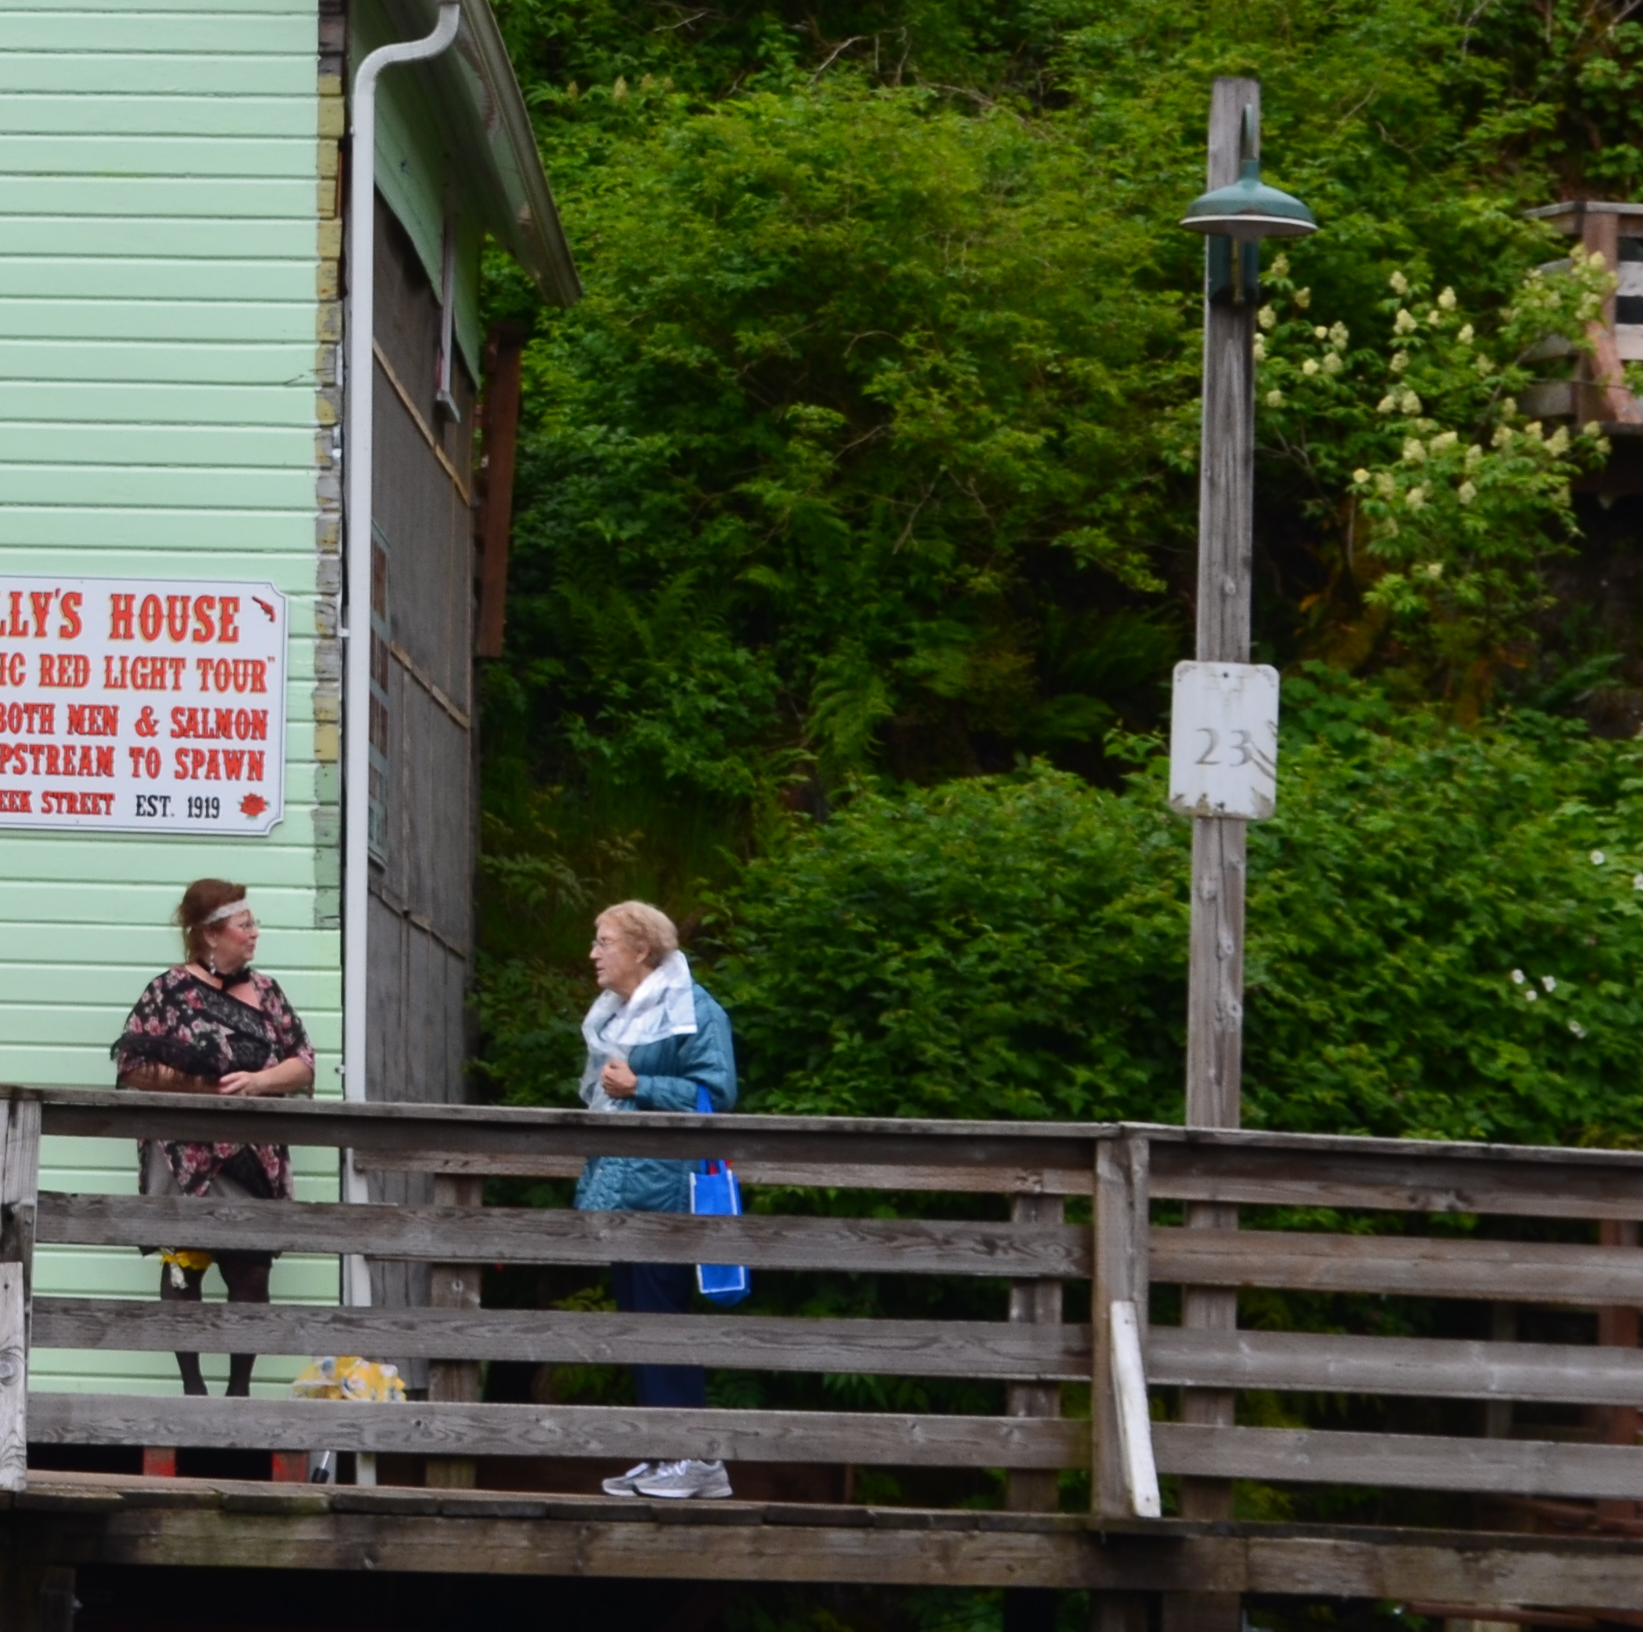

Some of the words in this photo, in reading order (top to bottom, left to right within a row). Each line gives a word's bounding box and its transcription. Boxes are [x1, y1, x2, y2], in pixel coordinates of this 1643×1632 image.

[108, 592, 241, 643] HOUSE
[38, 653, 91, 689] RED
[103, 654, 187, 691] LIGHT
[67, 703, 119, 736] MEN
[134, 704, 160, 737] &
[169, 705, 269, 740] SALMON
[128, 746, 162, 779] TO
[173, 747, 266, 781] SPAWN
[40, 790, 116, 815] STREET
[135, 794, 176, 818] EST.
[187, 795, 221, 819] 1919
